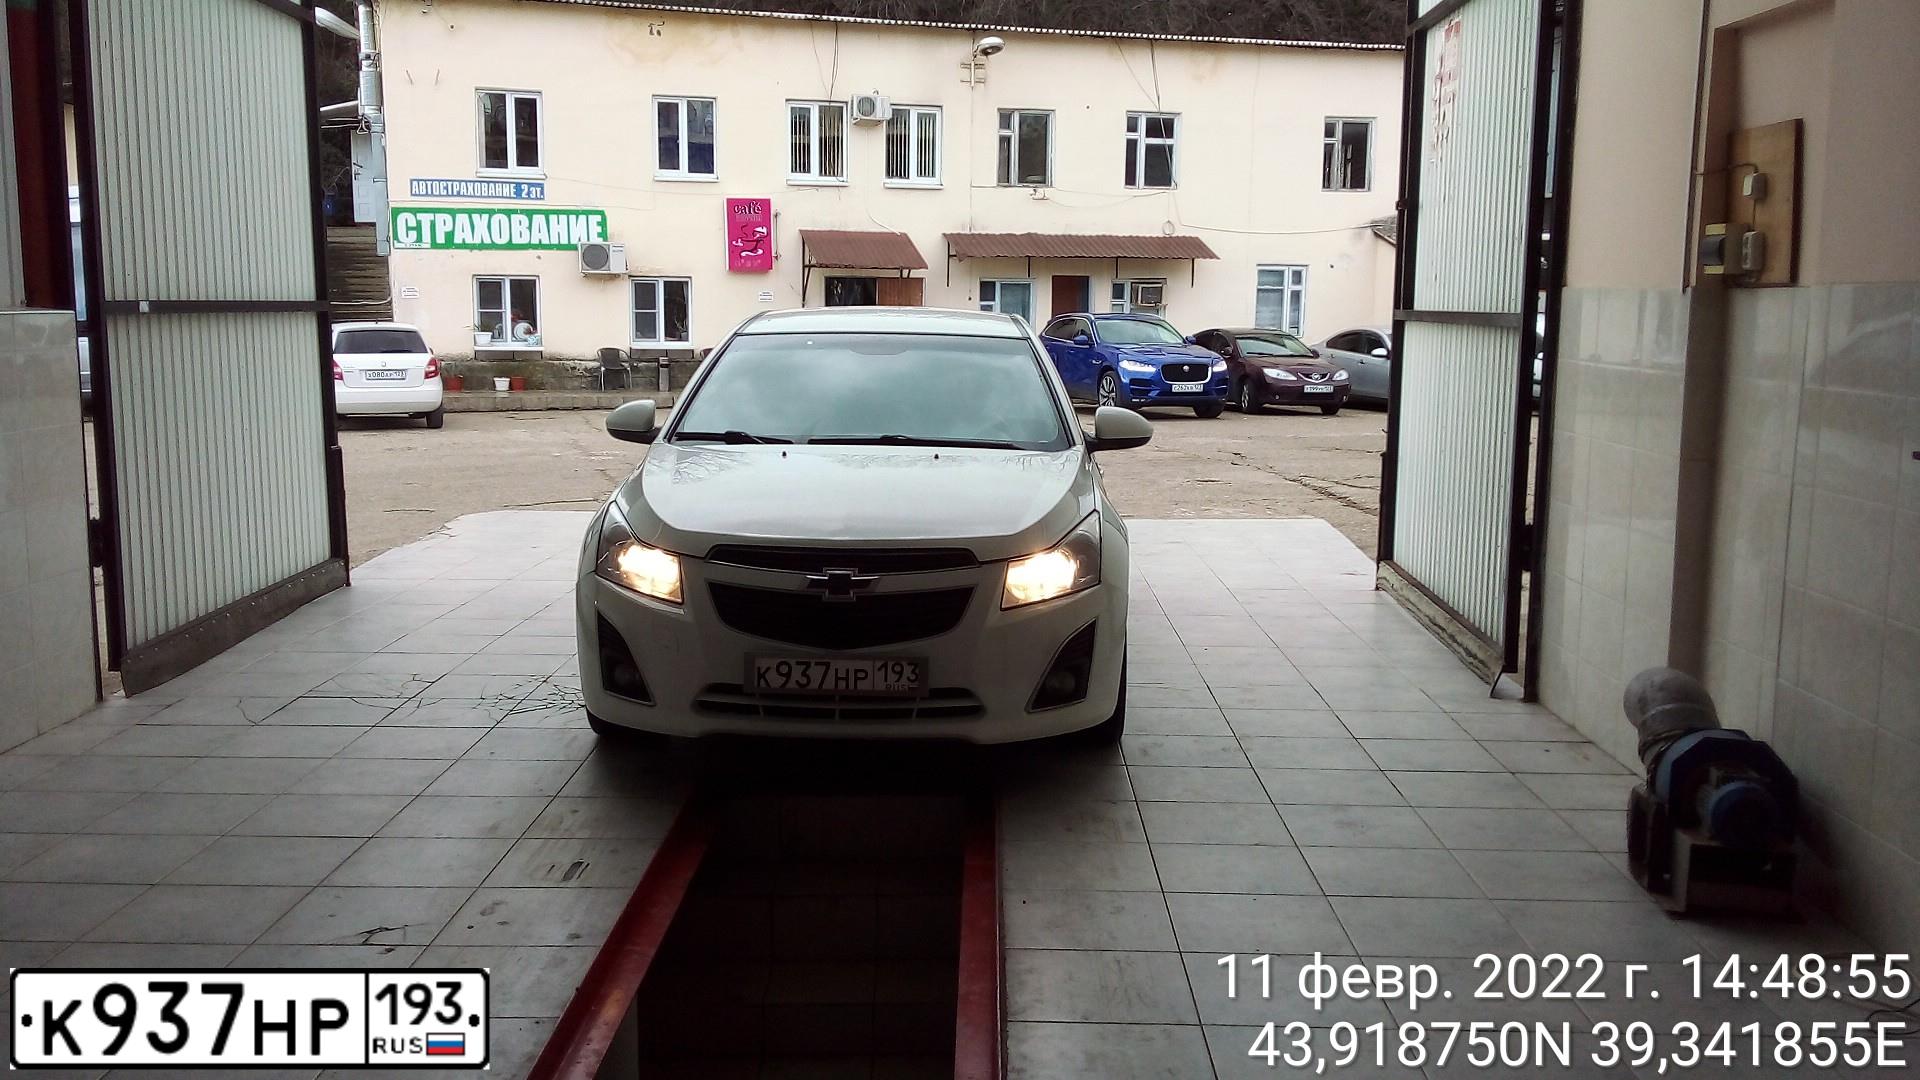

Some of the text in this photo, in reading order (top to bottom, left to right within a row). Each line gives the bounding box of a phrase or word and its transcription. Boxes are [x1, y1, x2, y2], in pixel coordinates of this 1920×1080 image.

[412, 181, 516, 198] АВТОСТРАХОВАНИЕ
[521, 184, 528, 198] 2
[734, 200, 762, 215] café
[396, 212, 604, 244] СТРАХОВАНИЕ
[756, 660, 920, 690] К937НР 193
